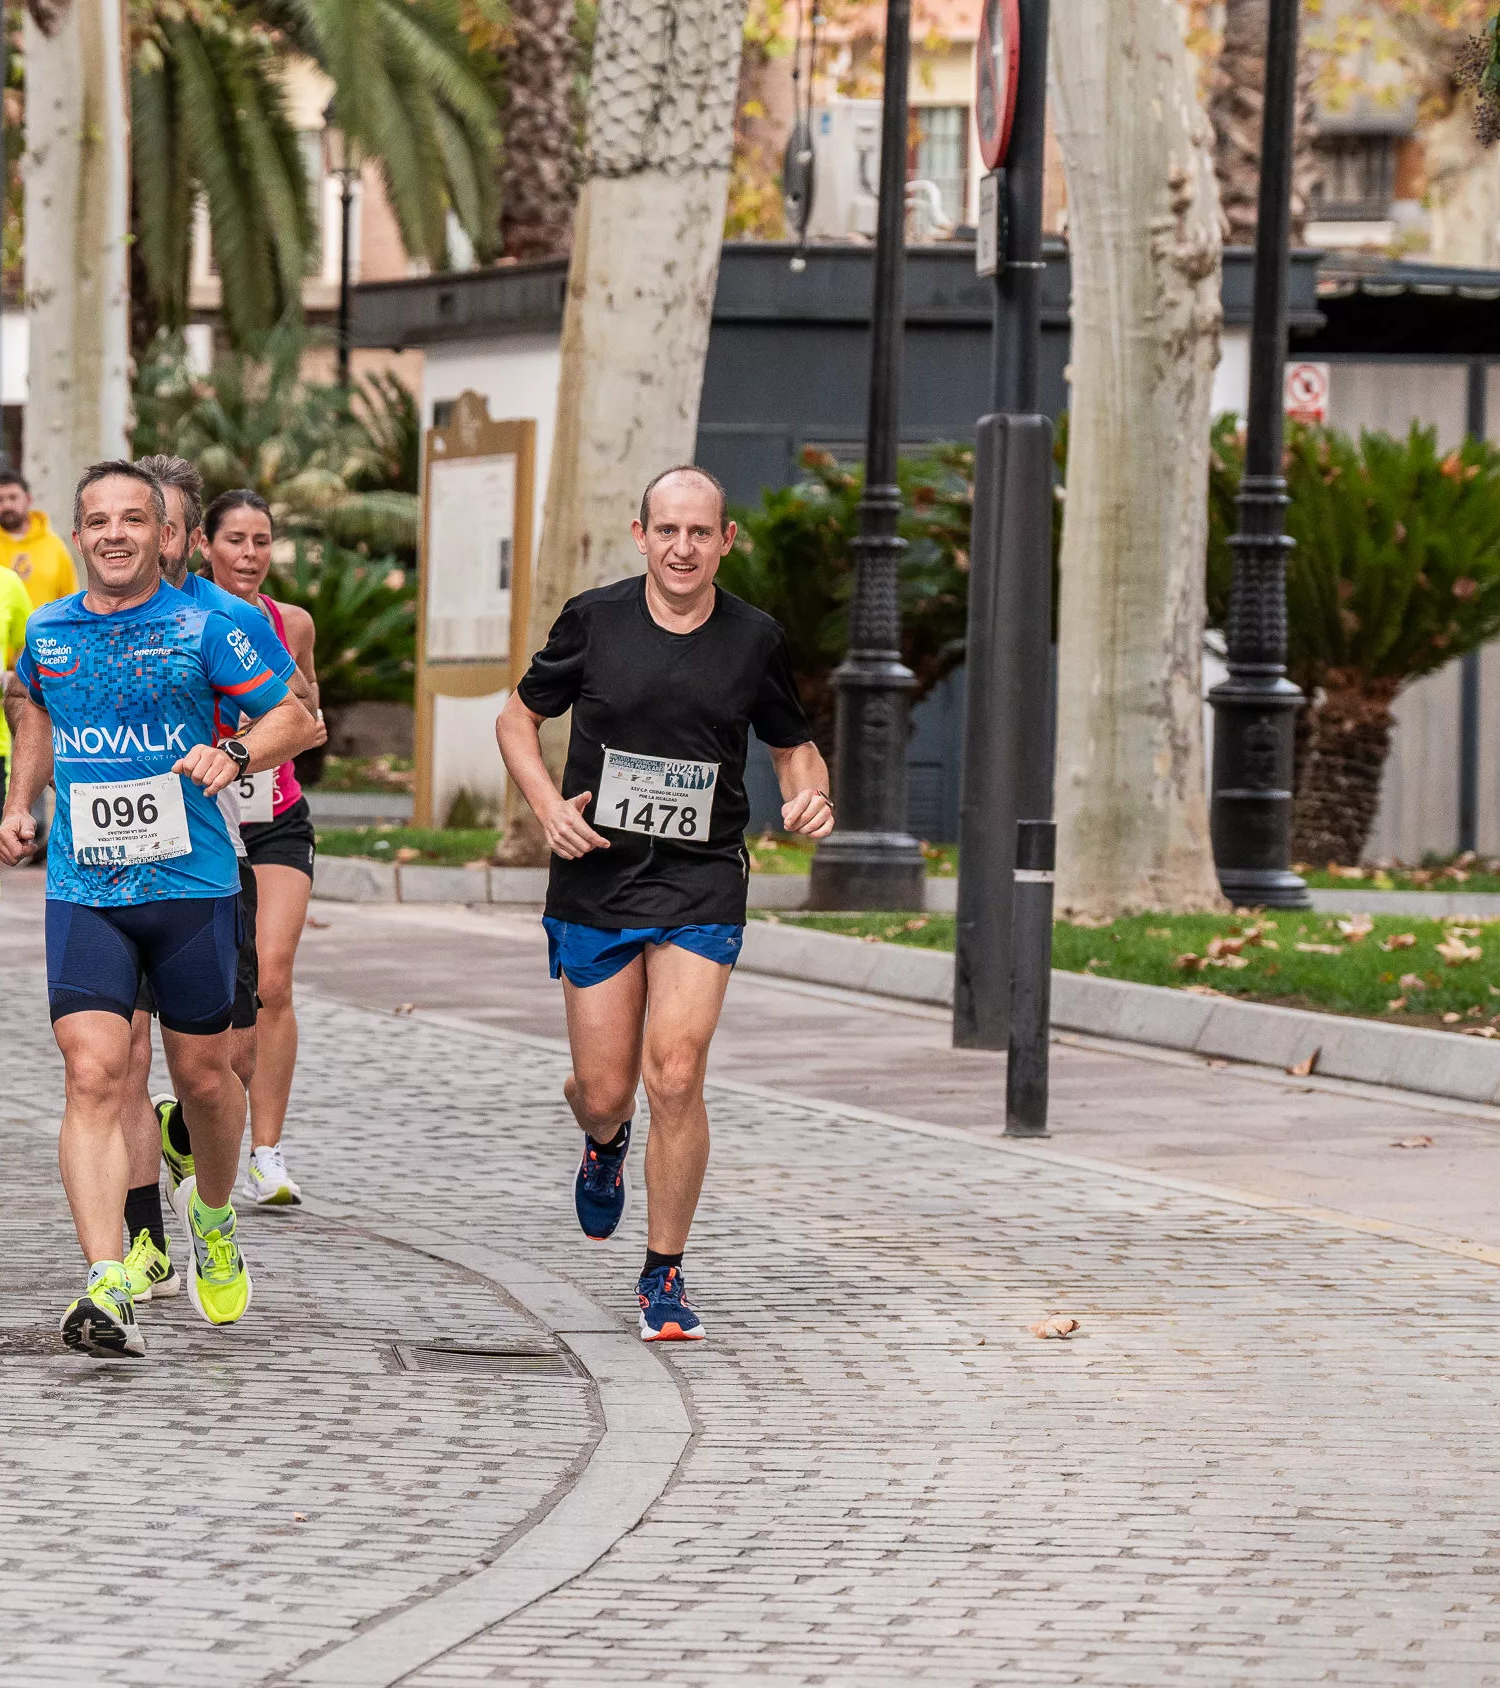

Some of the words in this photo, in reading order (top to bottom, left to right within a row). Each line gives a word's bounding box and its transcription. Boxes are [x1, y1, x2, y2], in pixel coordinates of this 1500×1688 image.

[36, 637, 57, 648] Club
[37, 644, 72, 657] Maratón
[133, 647, 173, 657] enerplus
[40, 655, 68, 665] Lucena
[665, 762, 694, 774] 2024
[615, 798, 697, 837] 1478
